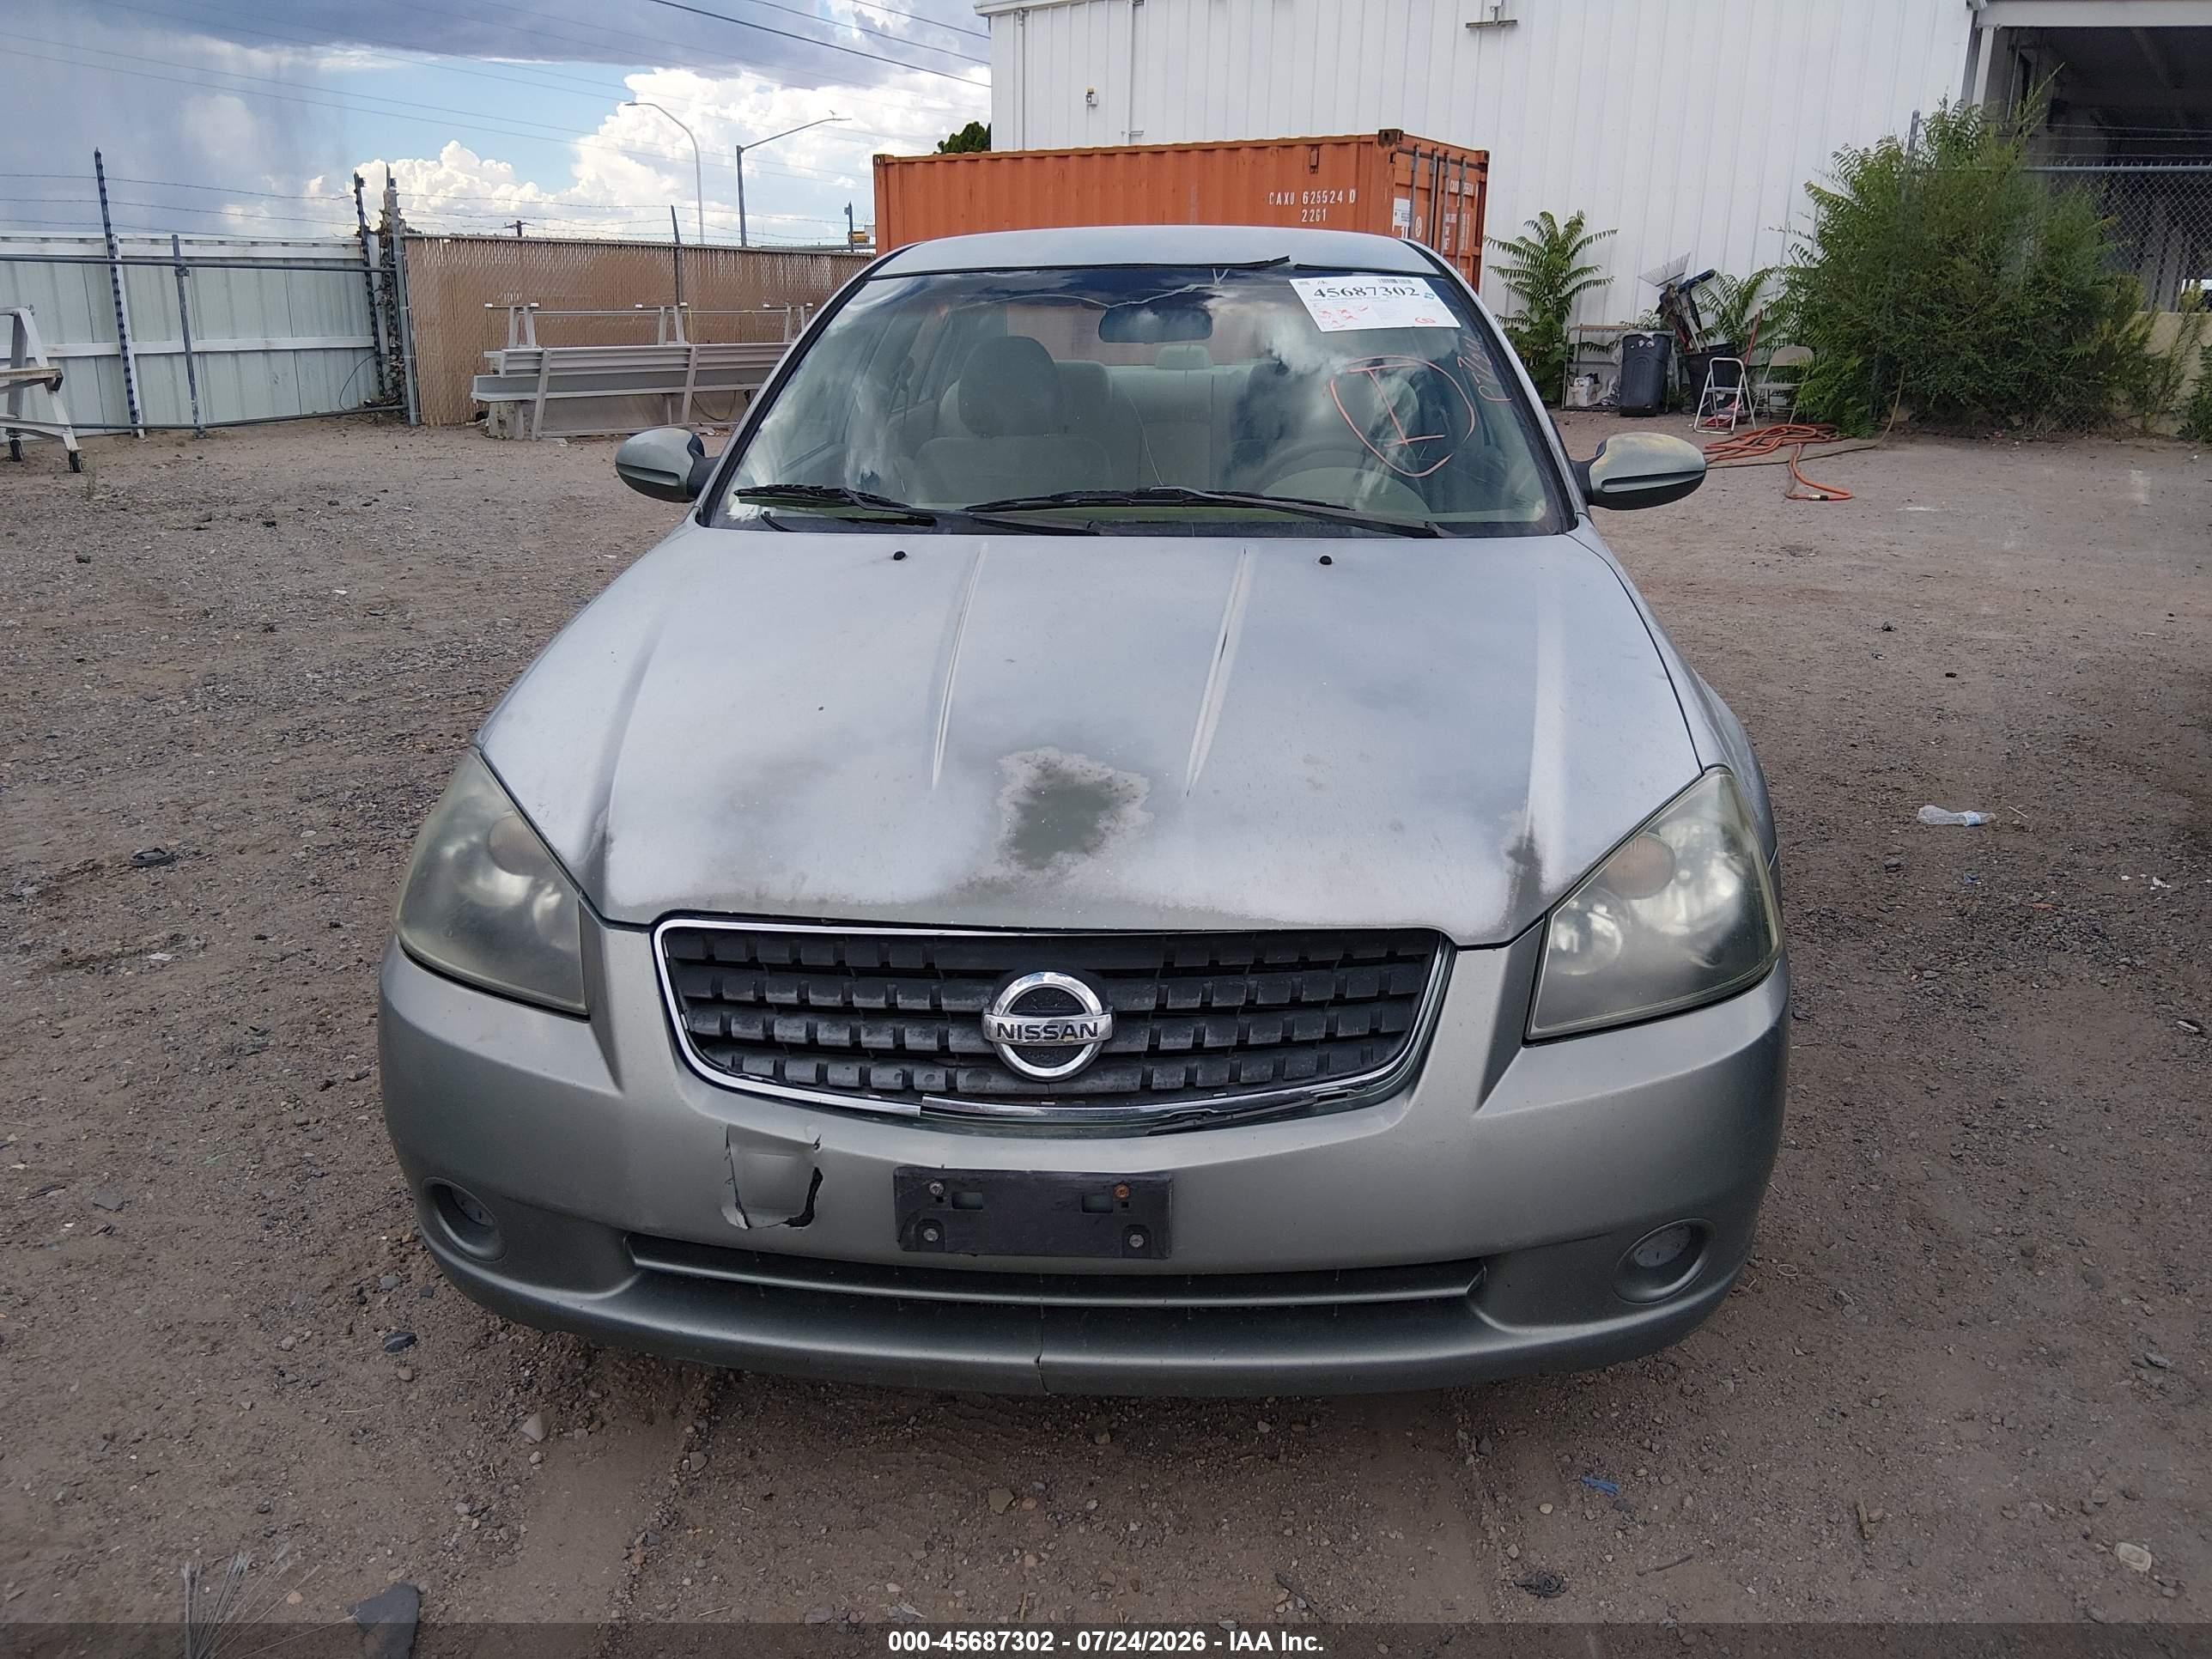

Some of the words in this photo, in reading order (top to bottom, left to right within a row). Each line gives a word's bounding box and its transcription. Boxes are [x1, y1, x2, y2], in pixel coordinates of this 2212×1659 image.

[1269, 191, 1295, 206] CAXU
[1302, 190, 1343, 205] 625524
[1314, 286, 1420, 299] 45687302
[997, 1022, 1098, 1041] NISSAN
